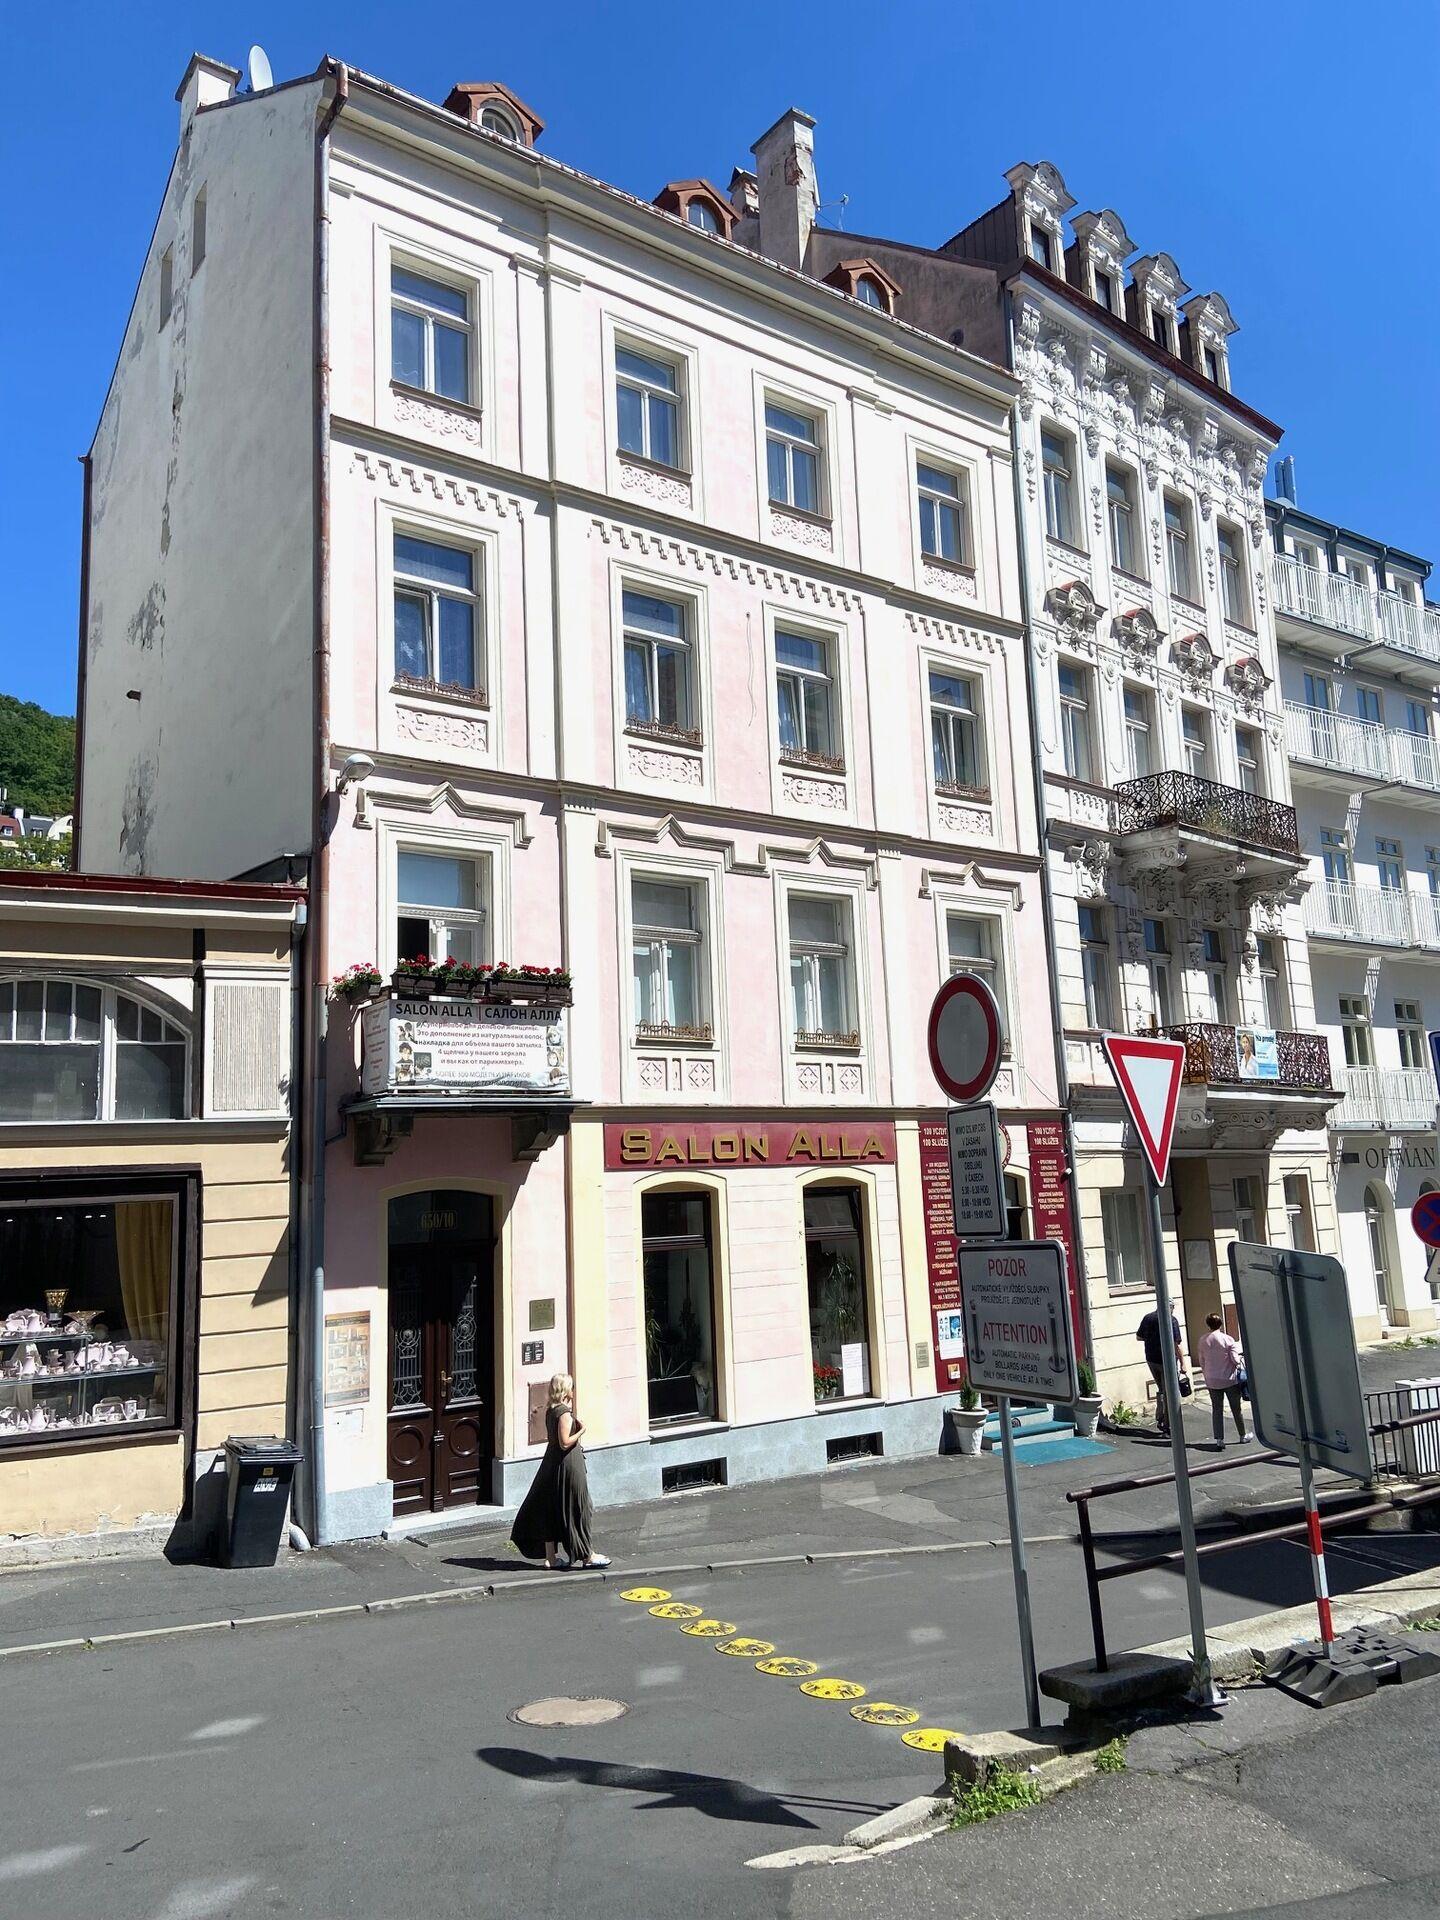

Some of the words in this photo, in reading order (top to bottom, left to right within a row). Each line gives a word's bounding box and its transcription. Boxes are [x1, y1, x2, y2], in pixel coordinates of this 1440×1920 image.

[396, 1003, 438, 1016] SALON
[441, 1006, 472, 1018] ALLA
[485, 1007, 527, 1020] САЛОН
[530, 1009, 562, 1021] АЛЛА
[621, 1129, 770, 1163] SALON
[786, 1129, 886, 1160] ALLA
[988, 1258, 1027, 1277] POZOR
[983, 1322, 1048, 1345] ATTENTION
[992, 1349, 1017, 1359] AUTOMATIC
[1018, 1352, 1041, 1362] PARKING
[1020, 1363, 1038, 1373] AHEAD
